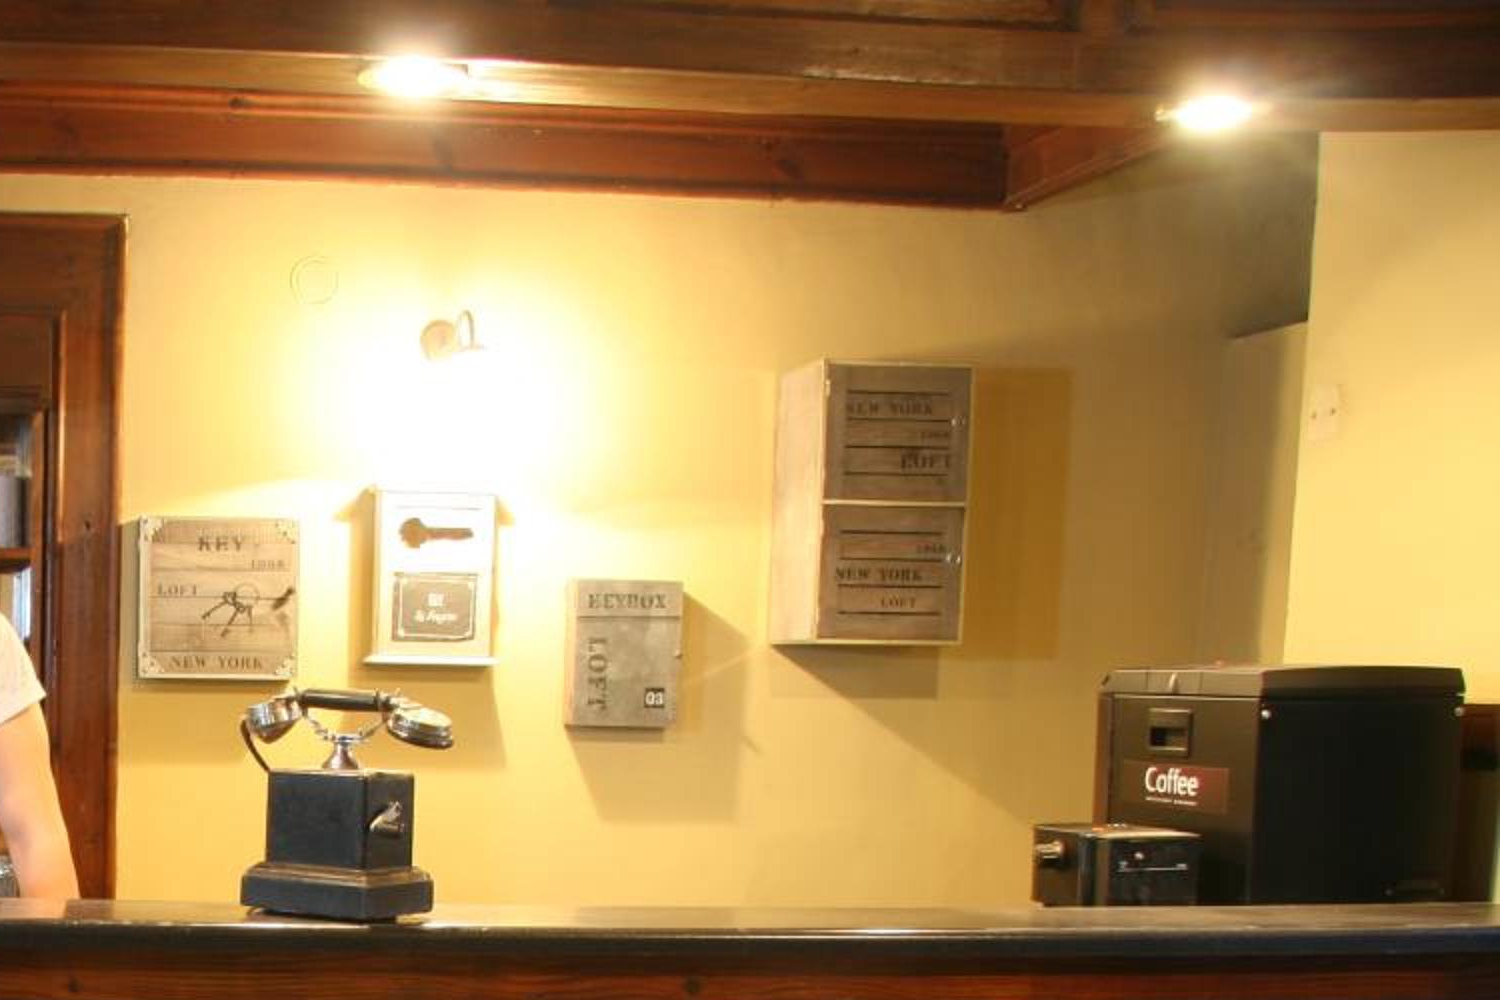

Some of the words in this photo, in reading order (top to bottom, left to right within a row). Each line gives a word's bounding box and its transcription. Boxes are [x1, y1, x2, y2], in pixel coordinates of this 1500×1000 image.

[198, 536, 245, 551] KEY
[836, 567, 869, 579] NEW
[879, 567, 923, 581] YORK
[157, 584, 198, 596] LOFT
[588, 593, 666, 609] KEYBOX
[881, 597, 916, 609] LOFT
[169, 656, 206, 669] NEW
[218, 656, 263, 670] YORK
[588, 637, 608, 710] LOFT
[1145, 766, 1199, 797] Coffee
